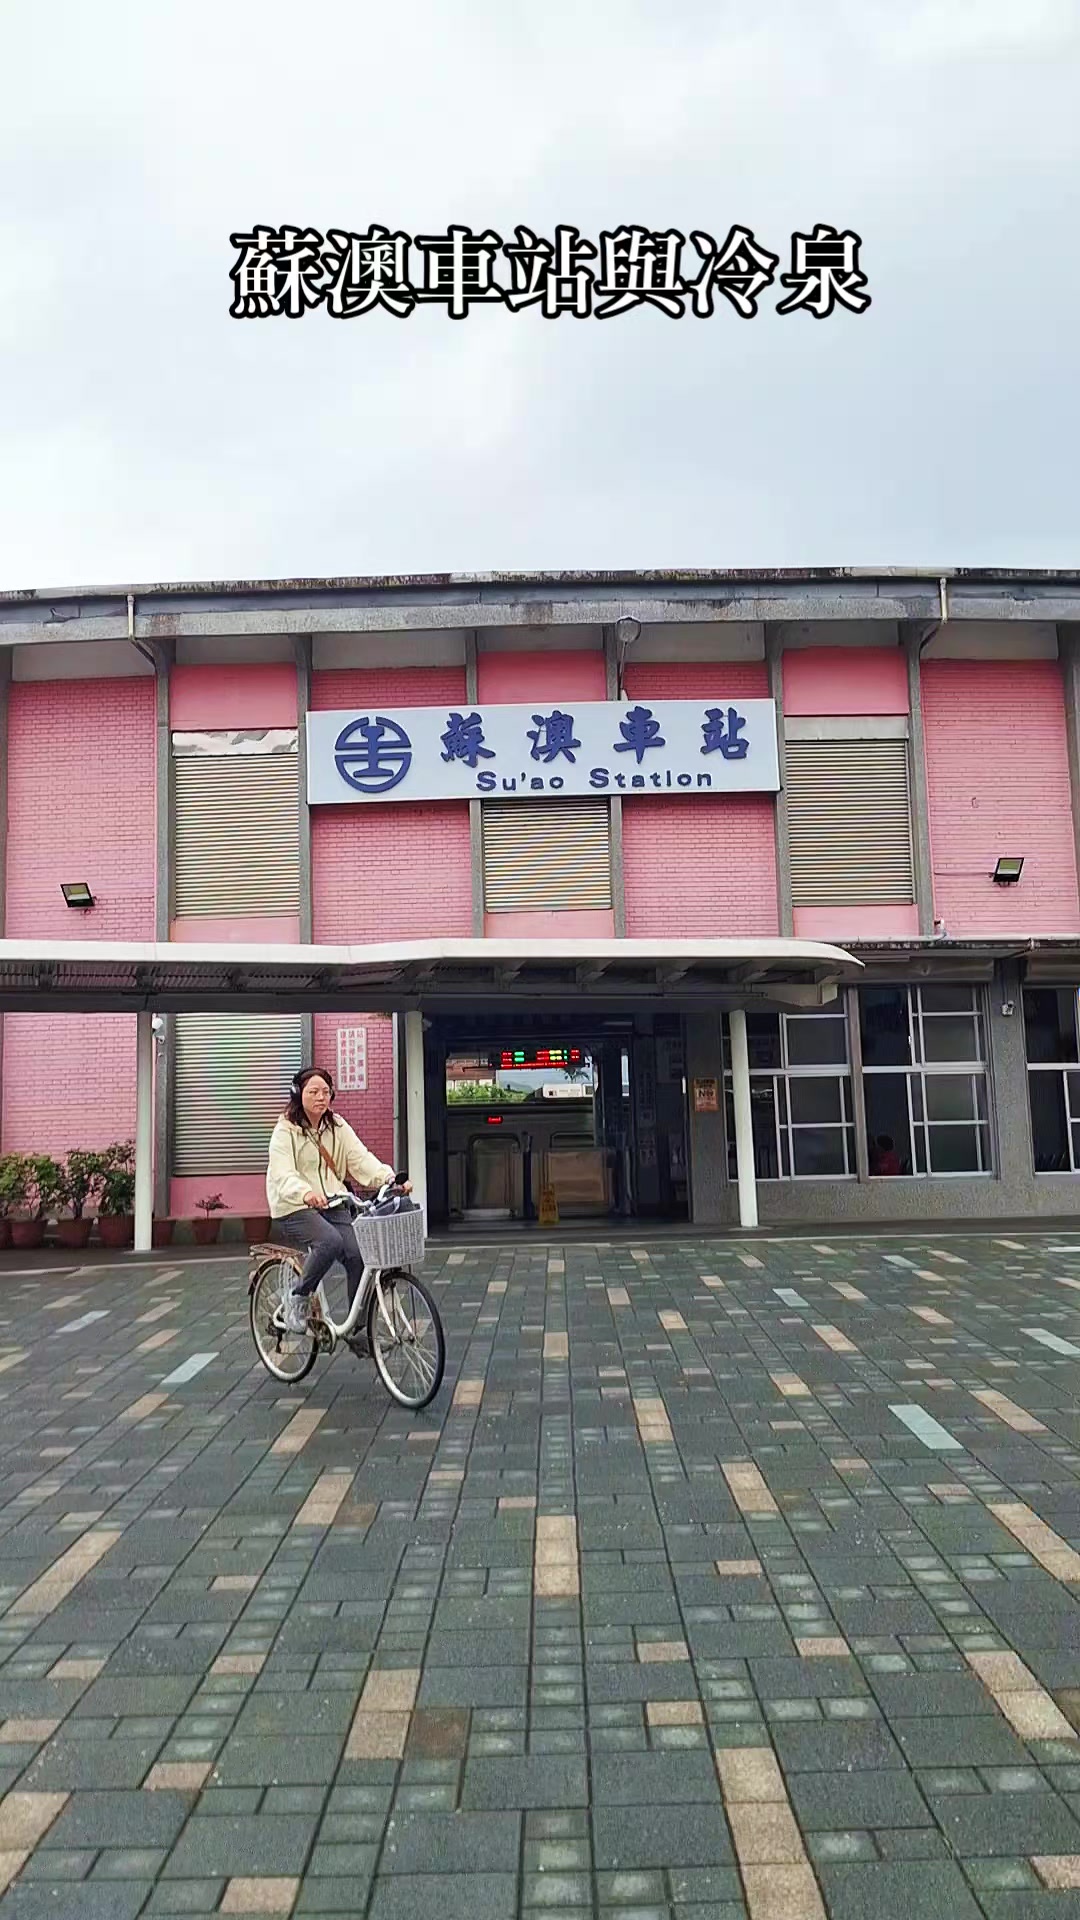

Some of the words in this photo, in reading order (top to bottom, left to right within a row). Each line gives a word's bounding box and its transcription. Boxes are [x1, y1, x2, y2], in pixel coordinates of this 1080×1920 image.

[440, 706, 750, 767] 蘇澳車站
[476, 770, 565, 792] Su'ao
[589, 767, 713, 789] Station
